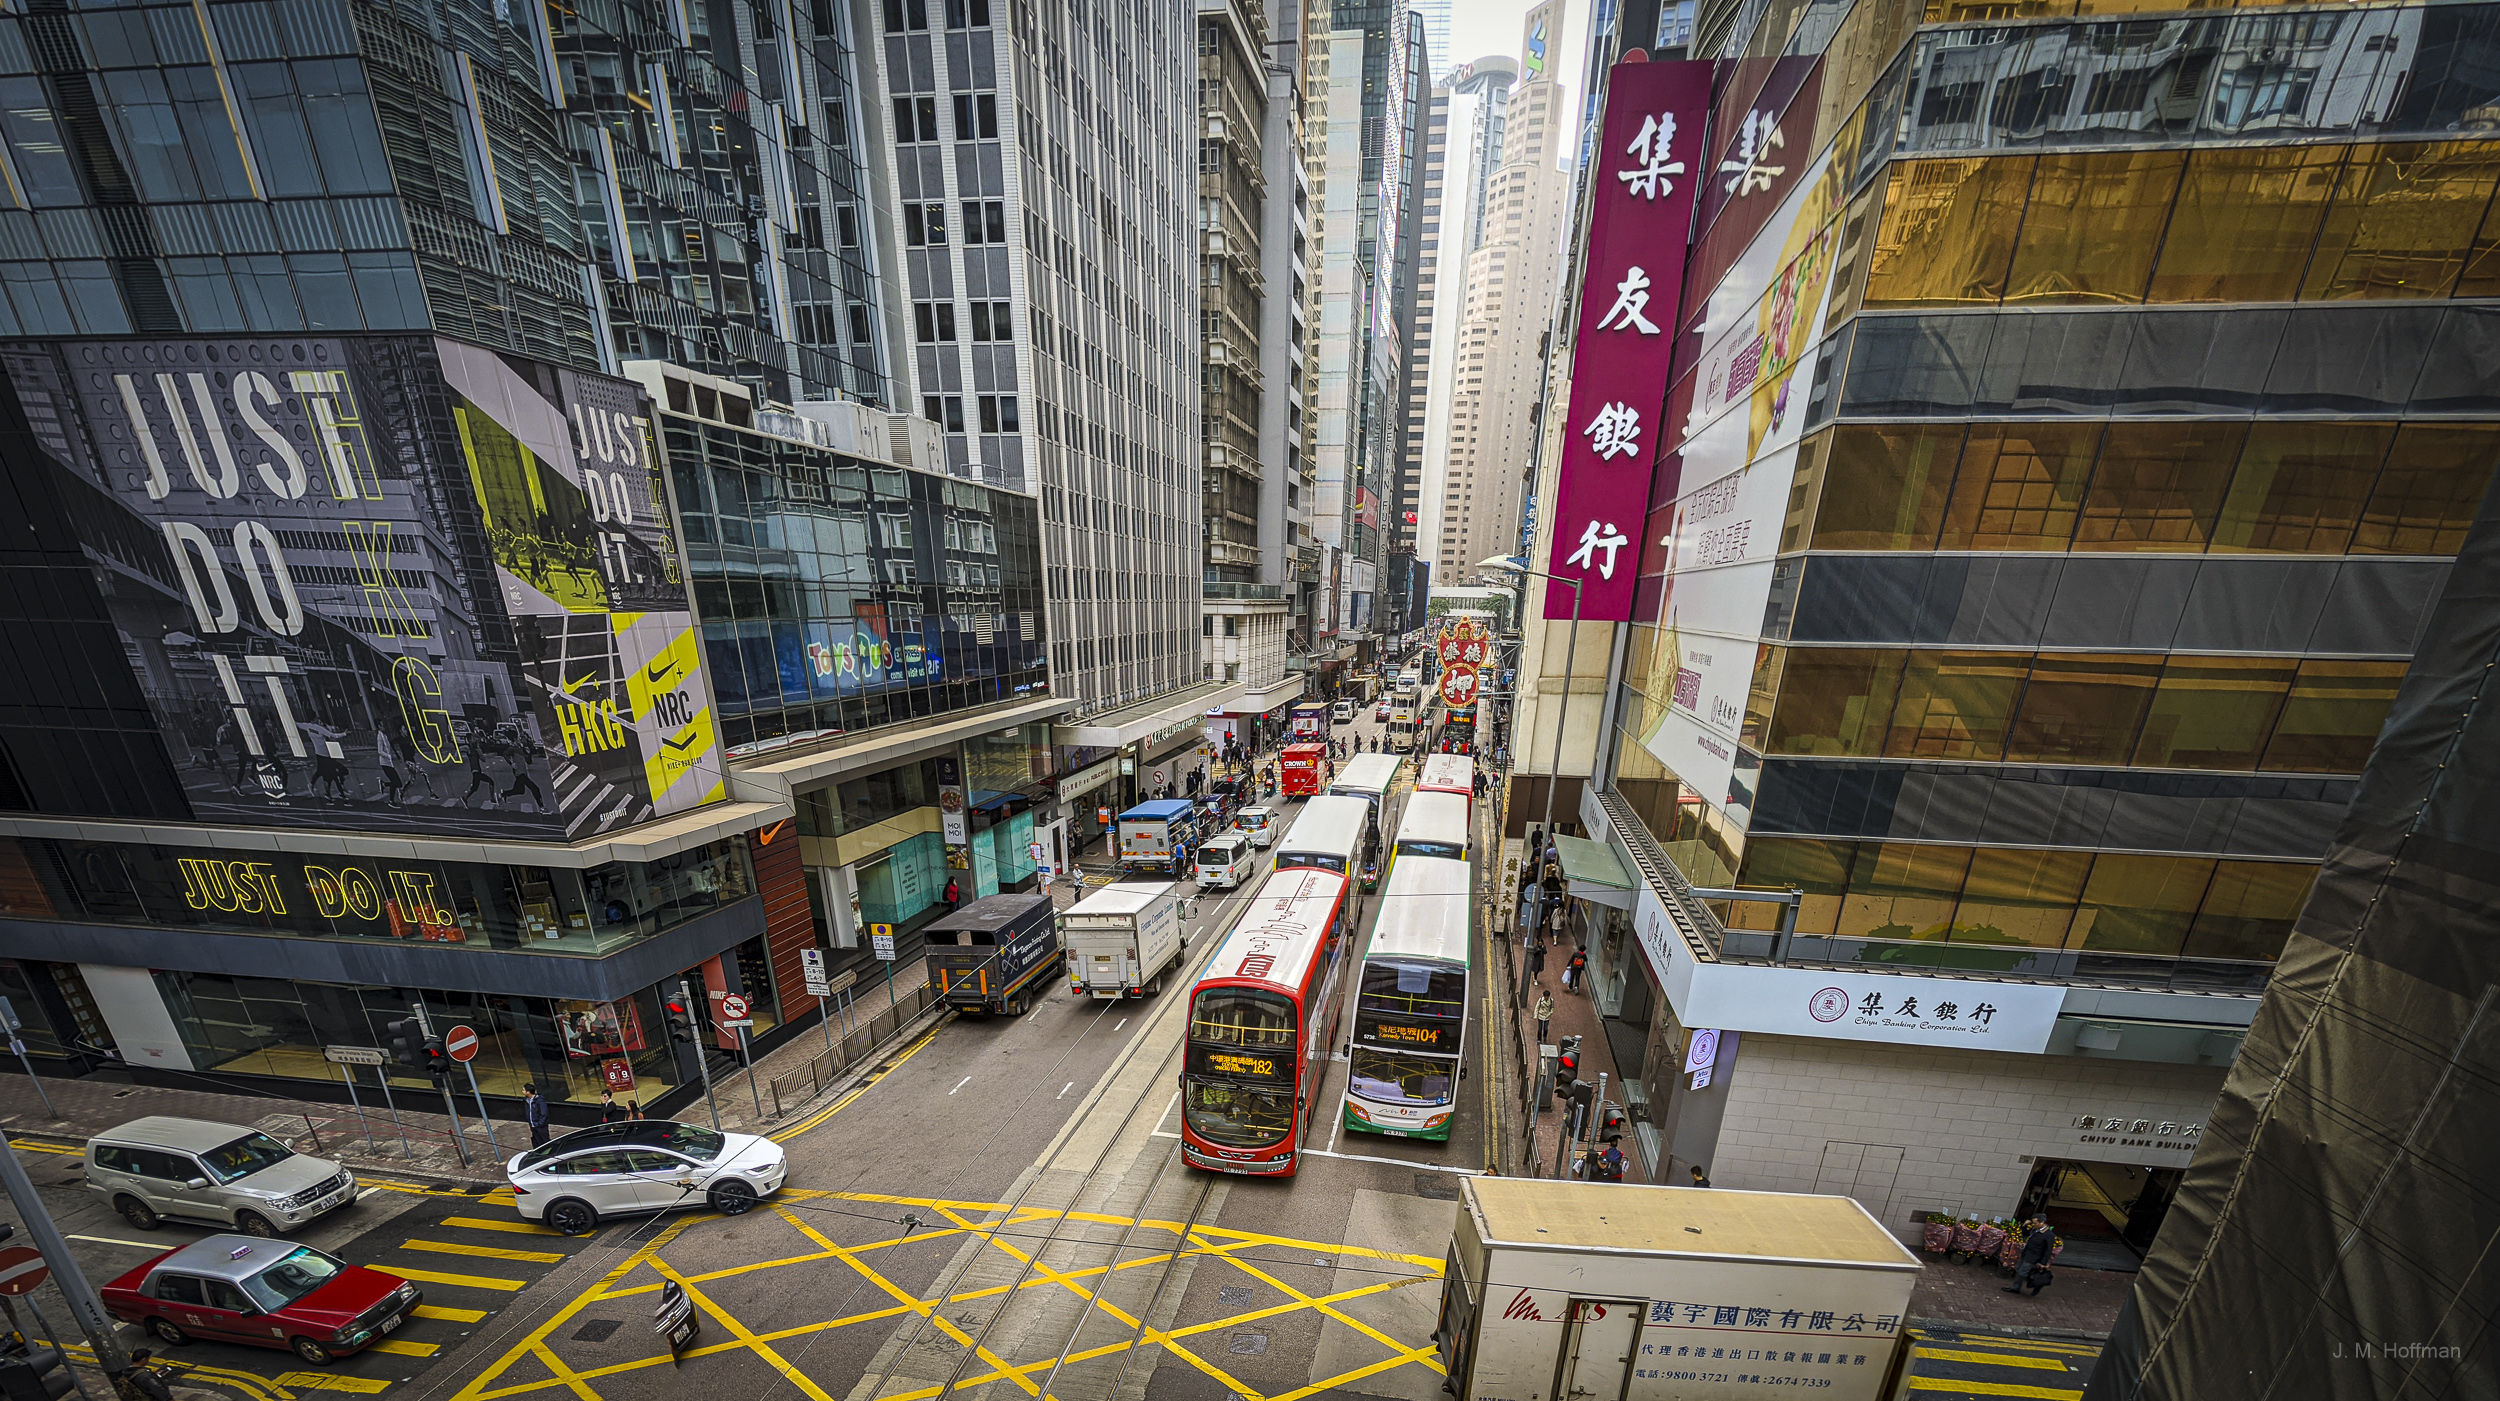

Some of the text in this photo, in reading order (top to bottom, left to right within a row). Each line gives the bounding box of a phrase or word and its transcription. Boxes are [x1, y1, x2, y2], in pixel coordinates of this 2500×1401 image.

[1566, 111, 1685, 580] 集友銀行
[114, 371, 358, 499] JUST
[574, 403, 651, 469] JUST
[584, 468, 633, 525] DO
[1381, 501, 1389, 533] FUR
[598, 531, 644, 584] IT.
[160, 521, 304, 636] DO
[927, 660, 941, 675] 2/F
[1444, 669, 1475, 702] 押
[212, 655, 344, 759] IT.
[652, 690, 693, 729] NRC
[556, 698, 626, 758] HKG
[259, 774, 283, 790] NRC
[947, 822, 962, 830] MOI
[948, 829, 962, 837] MOI
[178, 858, 452, 926] JUST DO IT.
[1854, 1016, 1991, 1034] Chiyu Banking Corporation Ltd.
[1857, 992, 1999, 1025] 集友銀行
[1379, 1032, 1400, 1041] Kennedy
[1416, 1028, 1438, 1043] 104
[1252, 1059, 1273, 1075] 182
[2080, 1134, 2117, 1144] CHIYU
[2120, 1138, 2153, 1147] BANK
[1650, 1301, 1900, 1334] 藝宇國際有限公司
[1640, 1344, 1867, 1366] 代理香港進出口散貨報關業務
[1699, 1372, 1729, 1383] 3721
[1800, 1377, 1832, 1388] 7339
